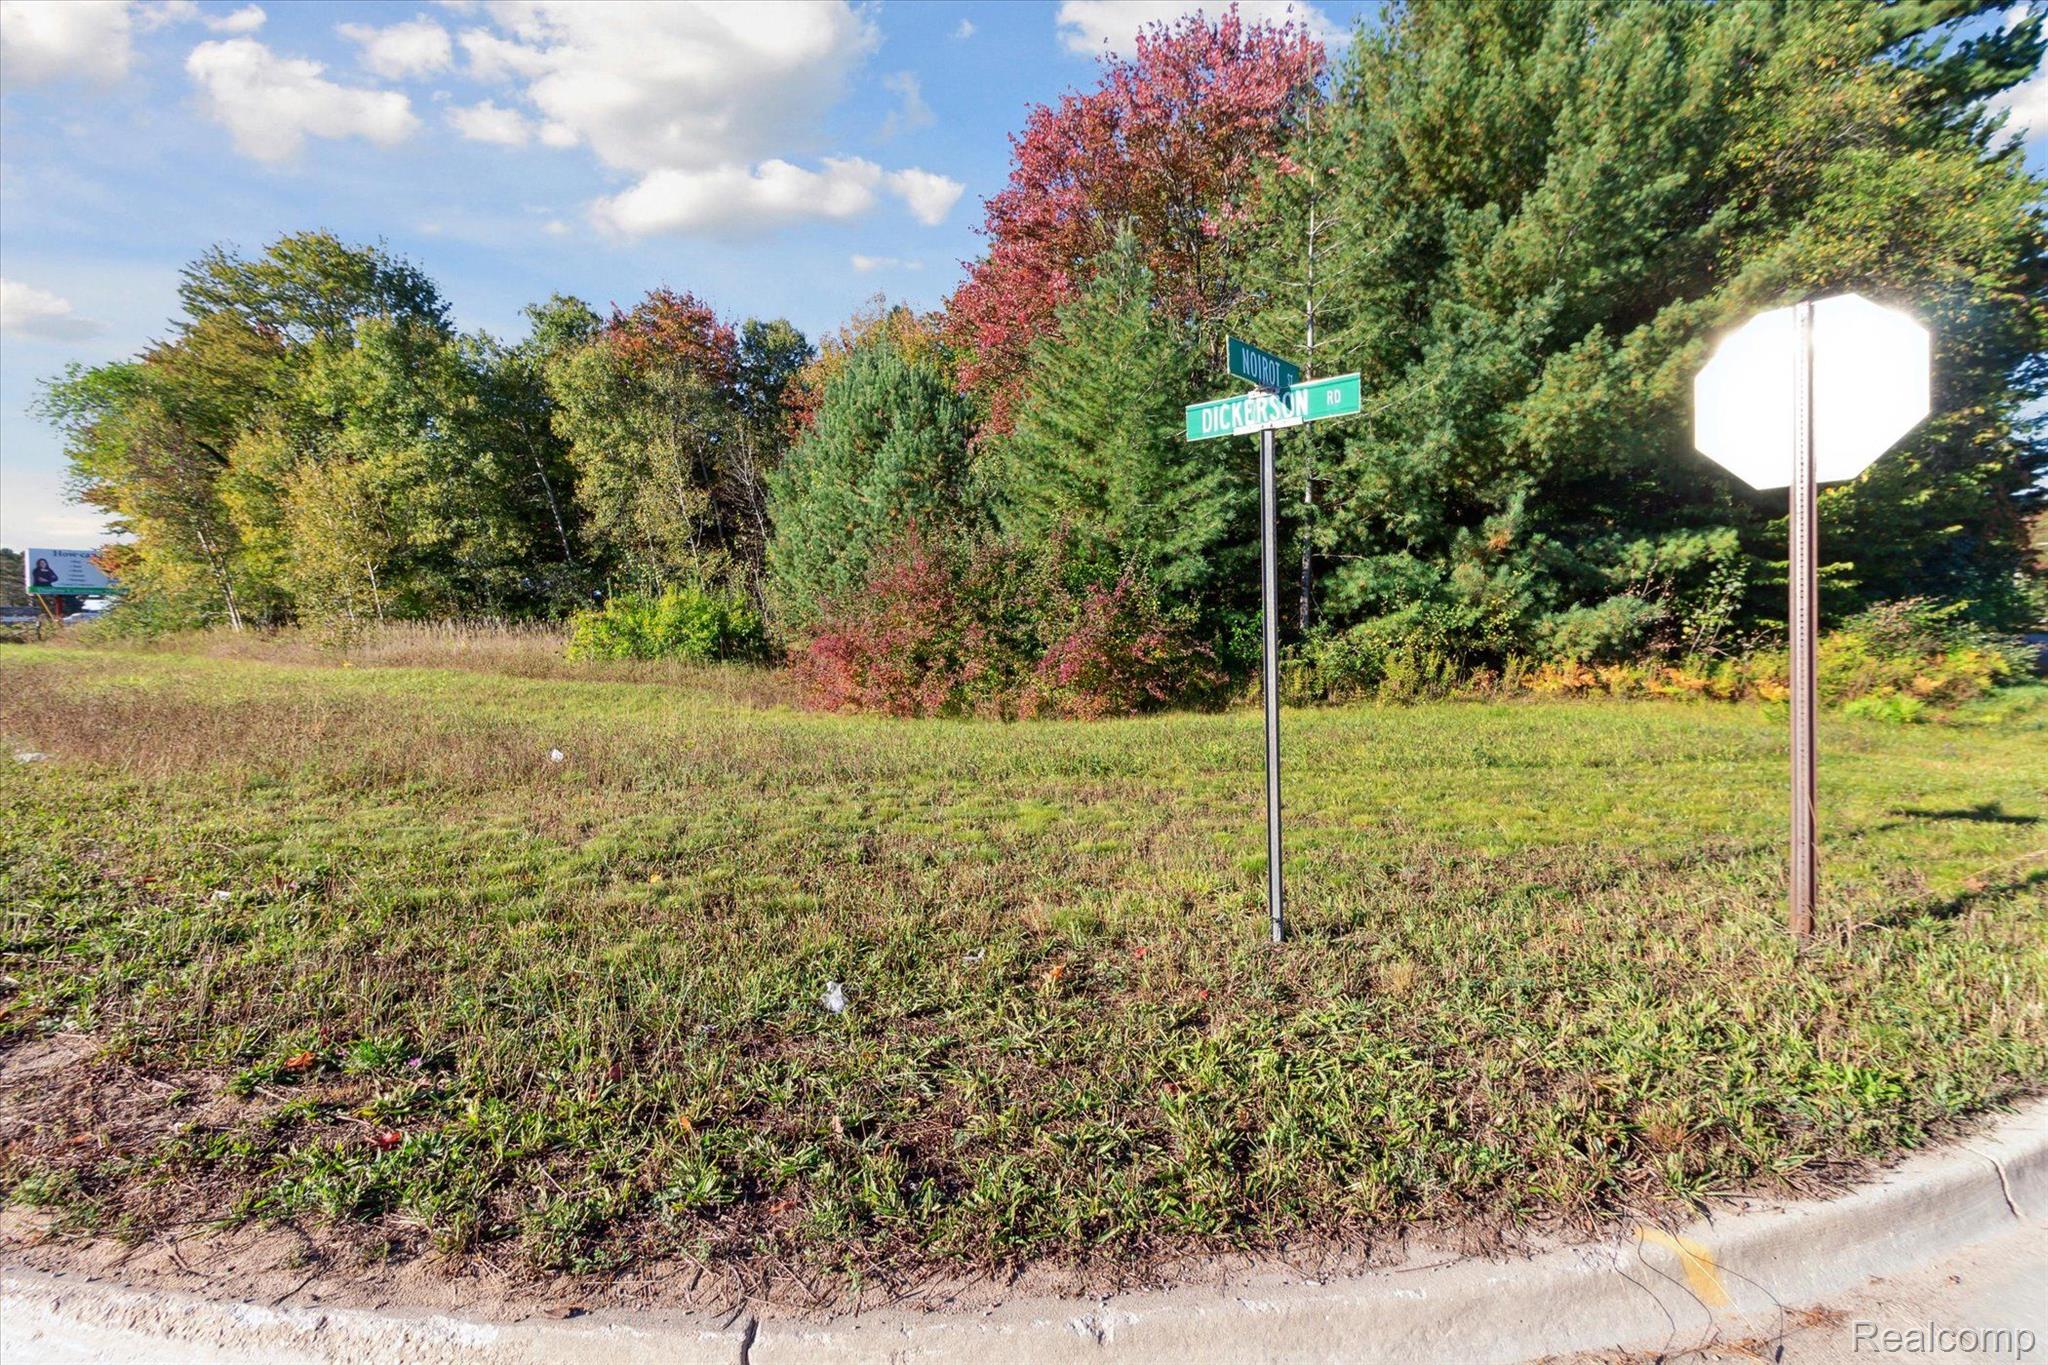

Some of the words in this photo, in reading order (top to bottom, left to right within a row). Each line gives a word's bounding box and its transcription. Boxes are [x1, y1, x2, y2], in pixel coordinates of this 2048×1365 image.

[1242, 347, 1281, 387] NOIROT
[1202, 389, 1309, 433] DICKERSON
[1326, 389, 1341, 405] RD
